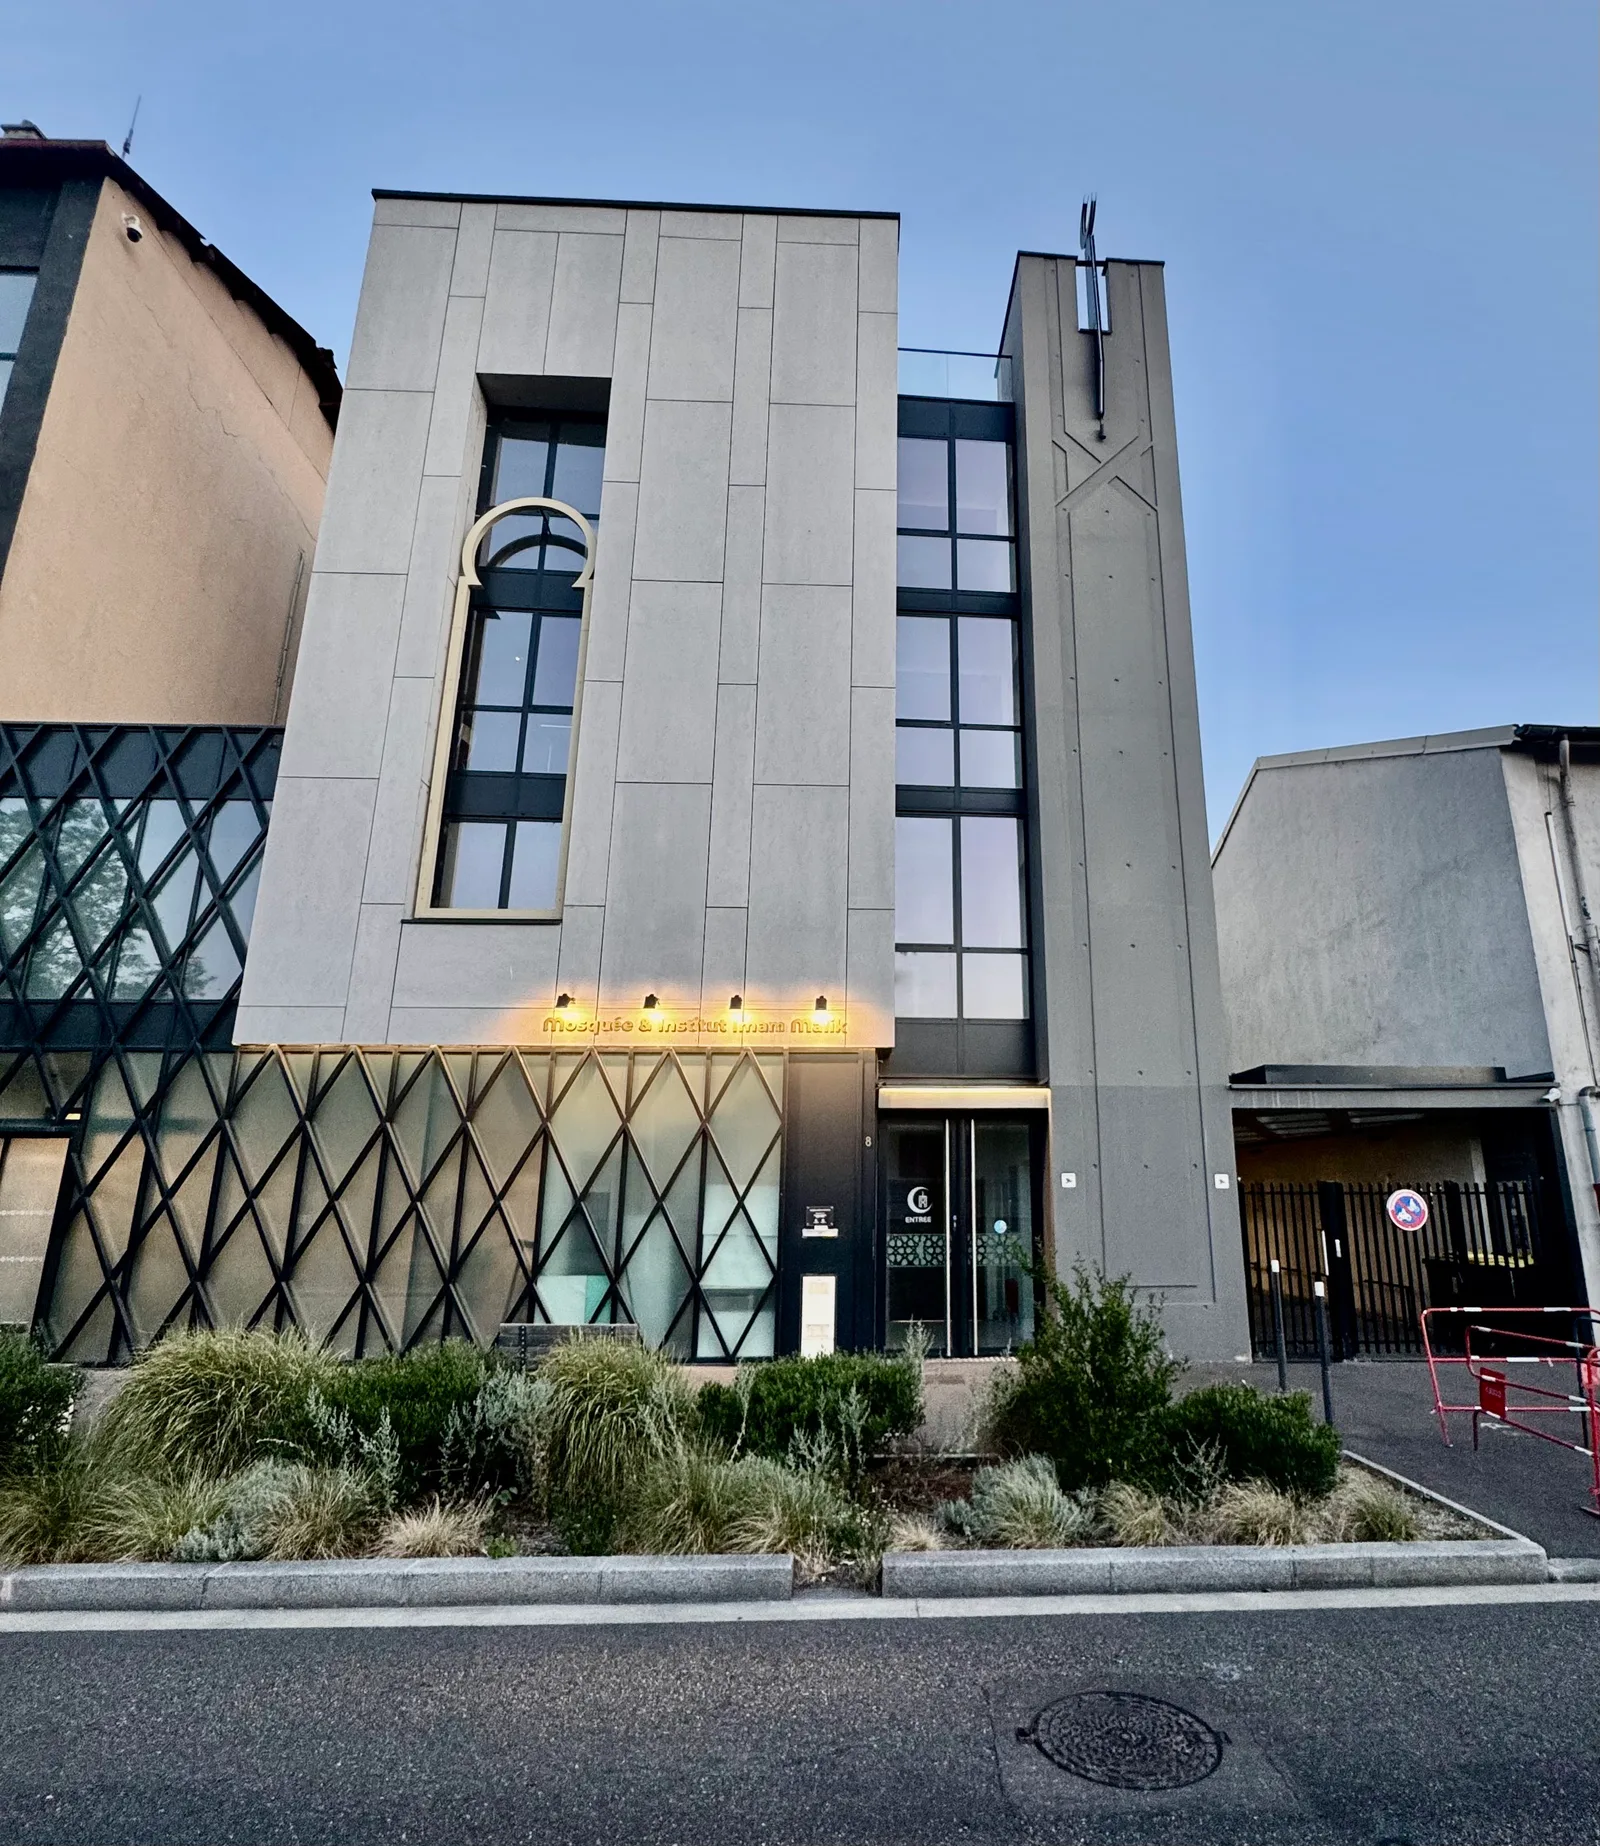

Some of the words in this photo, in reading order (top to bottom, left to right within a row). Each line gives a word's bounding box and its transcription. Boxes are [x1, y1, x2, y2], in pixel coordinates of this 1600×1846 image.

[543, 1017, 633, 1035] Mosquée
[638, 1018, 652, 1032] &
[658, 1016, 727, 1033] Institut
[732, 1019, 785, 1033] Imam
[865, 1136, 872, 1147] 8
